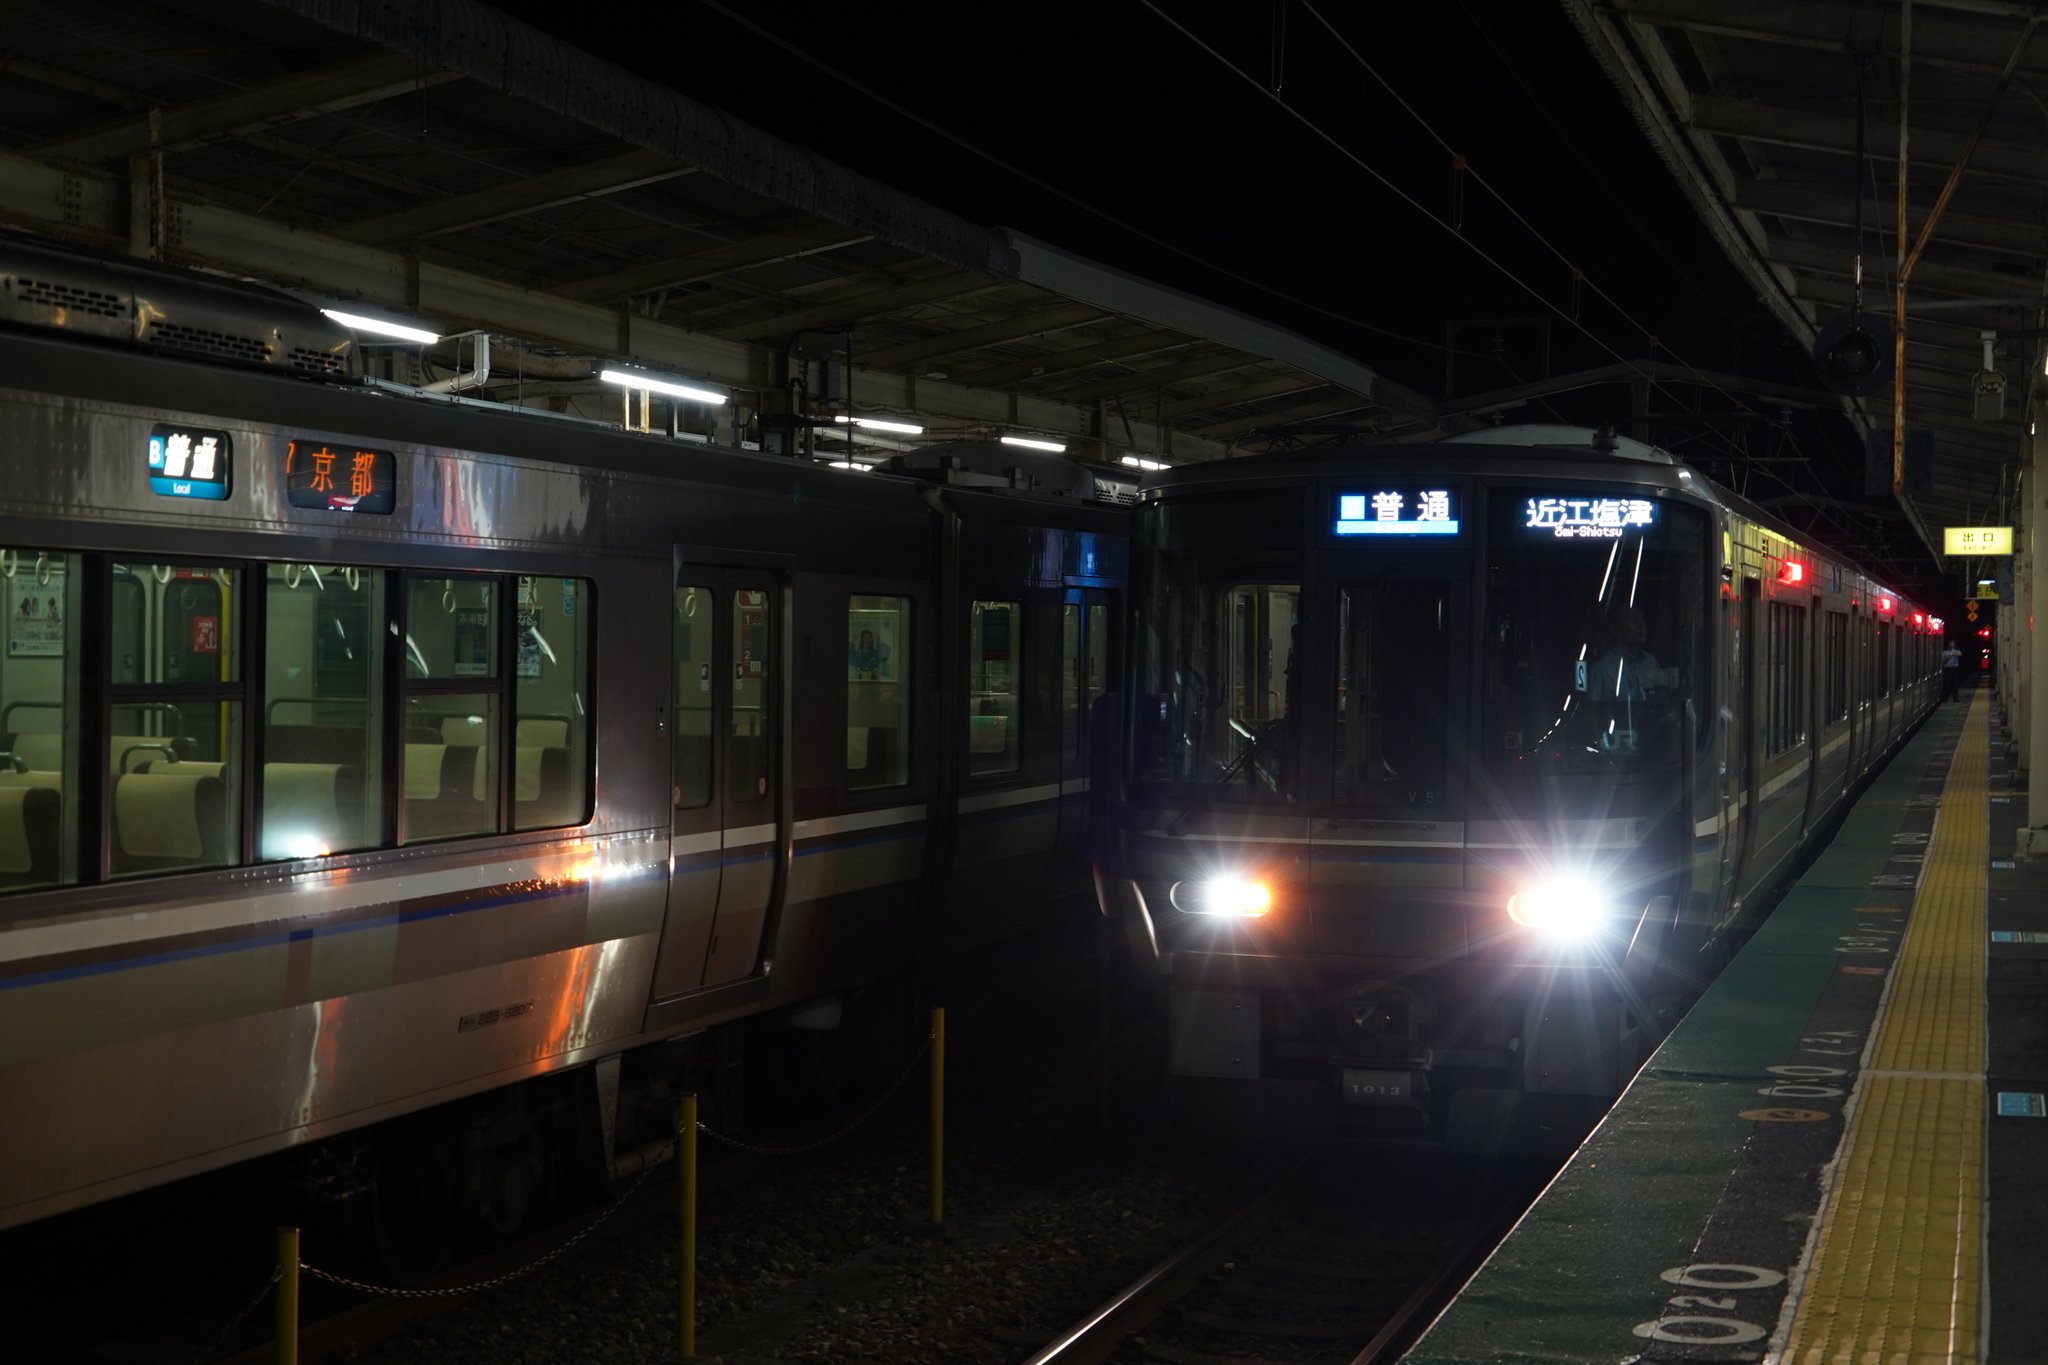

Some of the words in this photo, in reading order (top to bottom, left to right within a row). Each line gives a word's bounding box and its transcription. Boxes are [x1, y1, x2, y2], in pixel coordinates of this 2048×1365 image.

[163, 433, 218, 480] 普通
[310, 447, 375, 497] 京都
[173, 482, 191, 494] Local
[1371, 491, 1450, 521] 普通
[1526, 498, 1653, 527] 近江塩津
[1963, 532, 1994, 542] 出口
